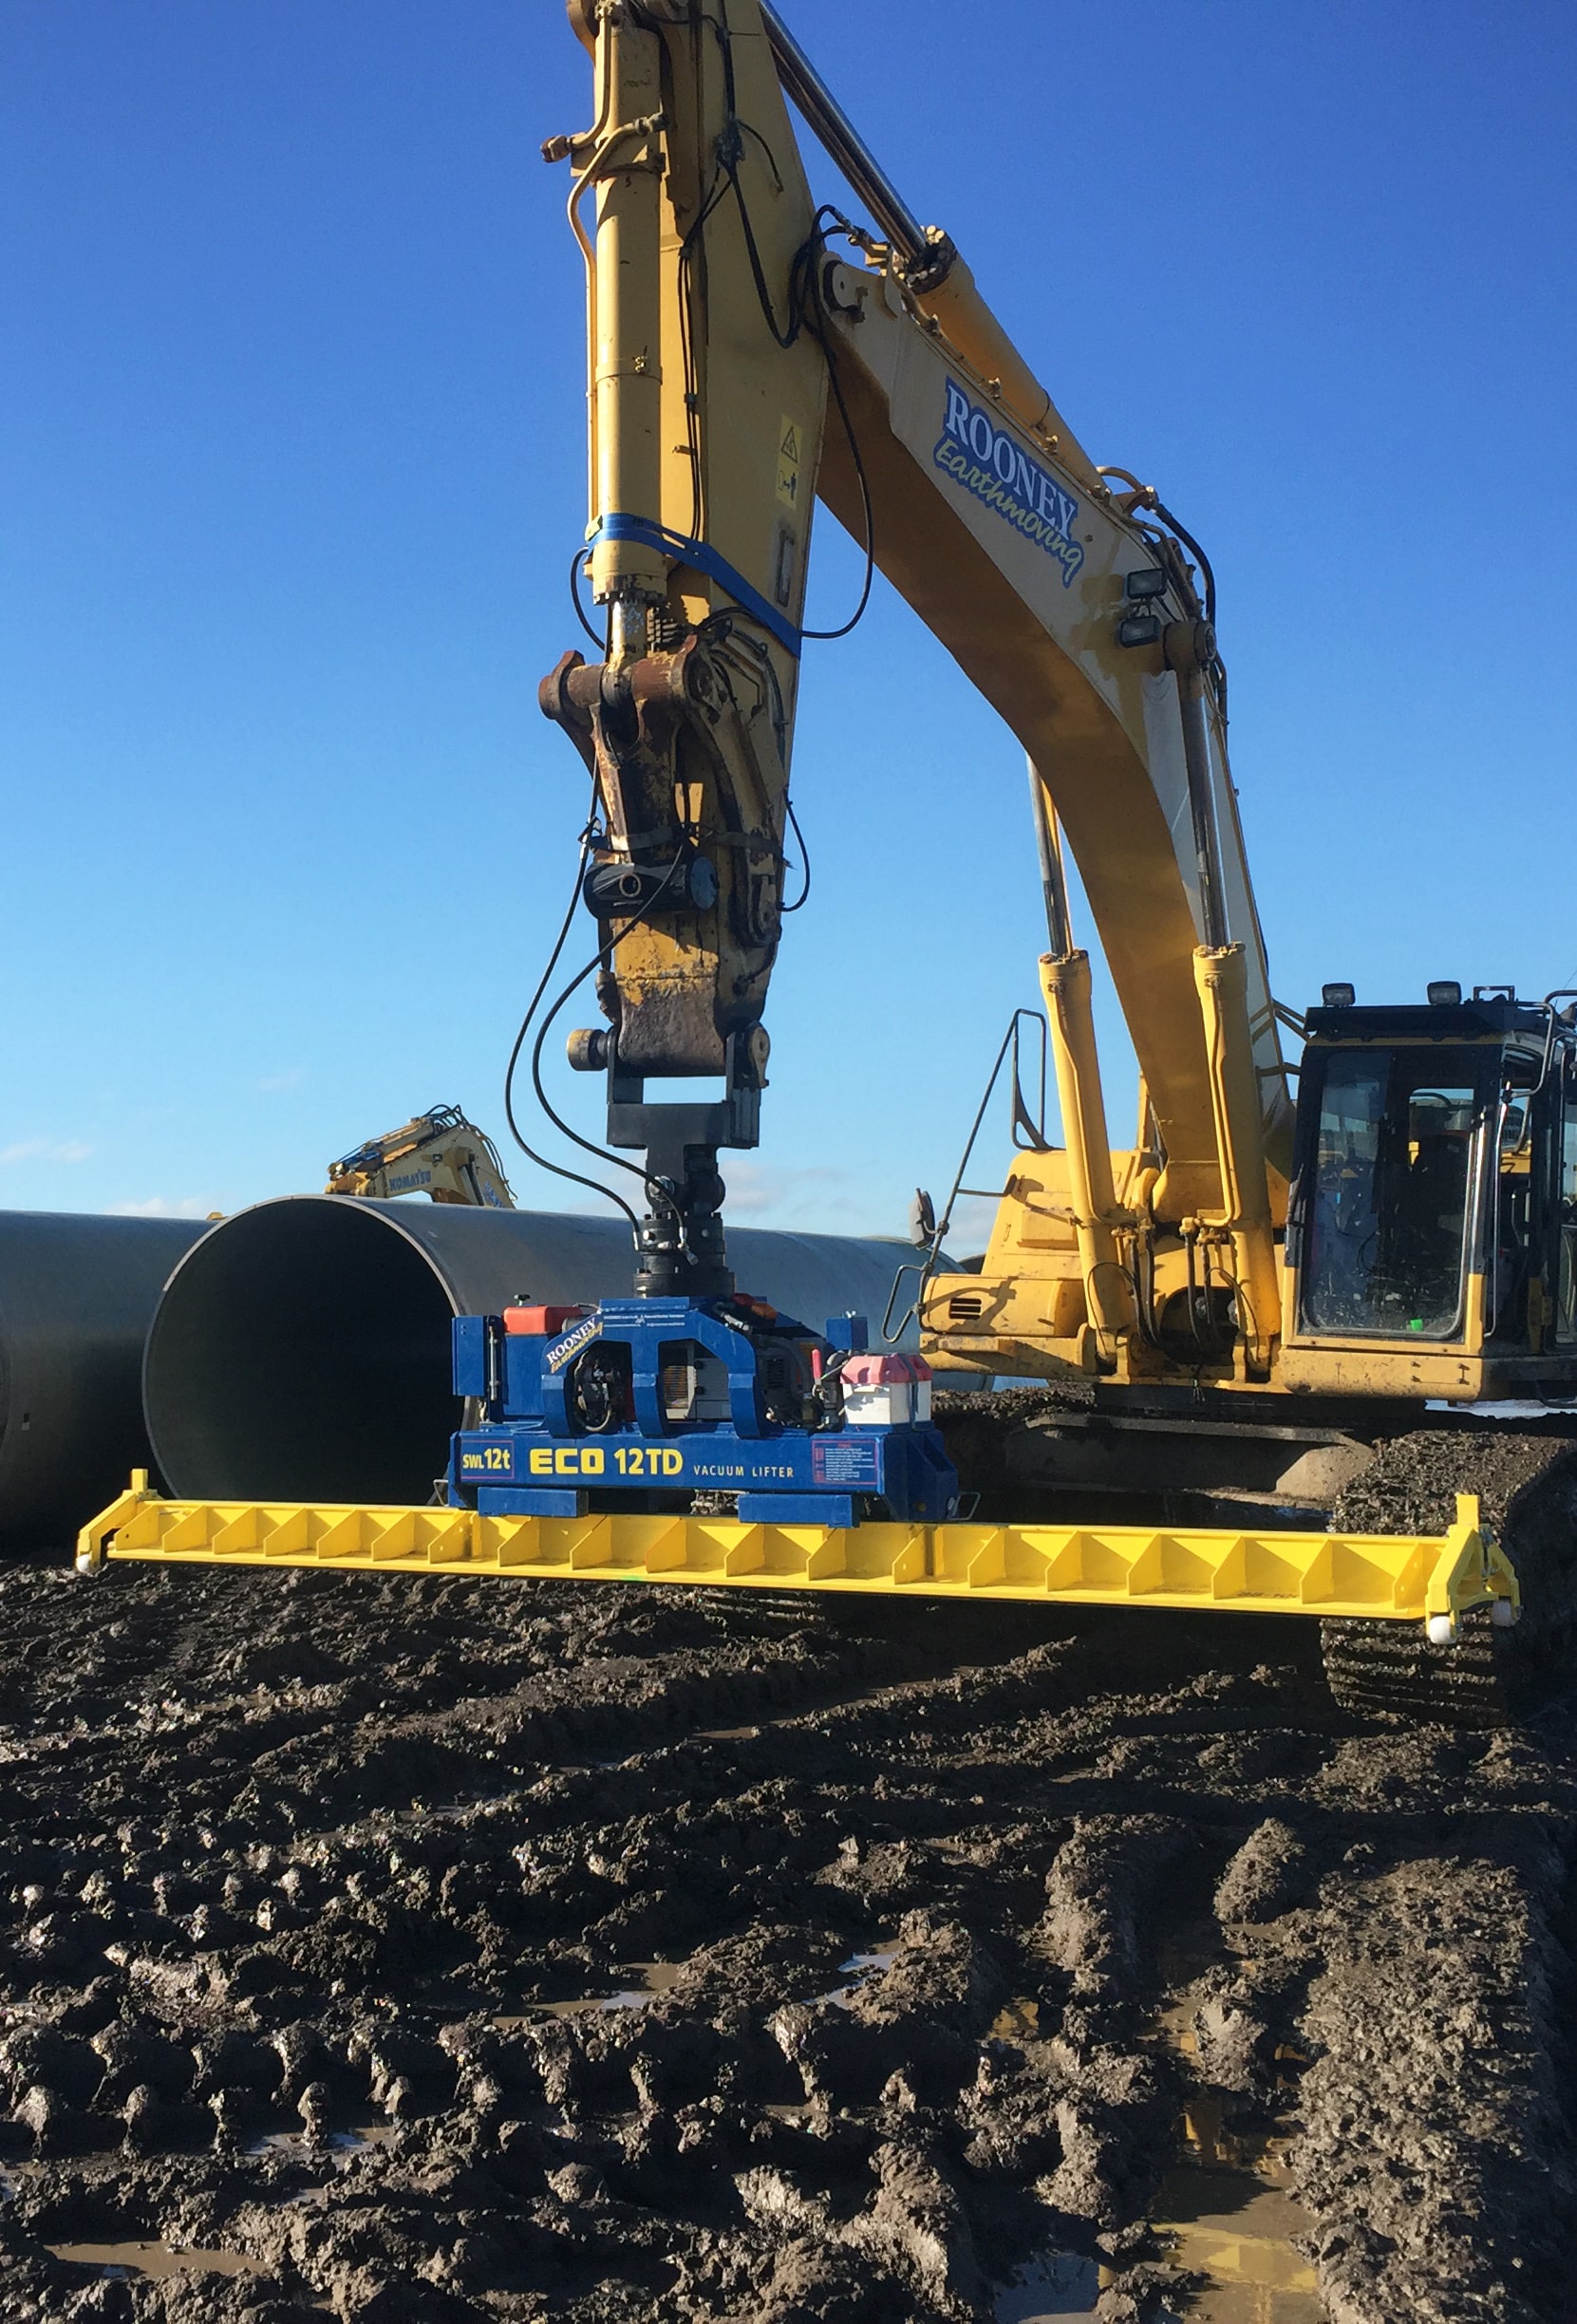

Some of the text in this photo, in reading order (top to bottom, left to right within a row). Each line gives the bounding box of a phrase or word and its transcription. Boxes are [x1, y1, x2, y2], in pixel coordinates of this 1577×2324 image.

[947, 385, 1076, 541] ROONEY
[936, 439, 1082, 583] Earthmoving
[389, 1169, 431, 1191] KOMATSU
[546, 1317, 596, 1364] ROONEY
[462, 1448, 511, 1471] SWL 12t
[530, 1448, 684, 1475] ECO 12TD
[693, 1465, 795, 1479] VACUUM LIFTER
